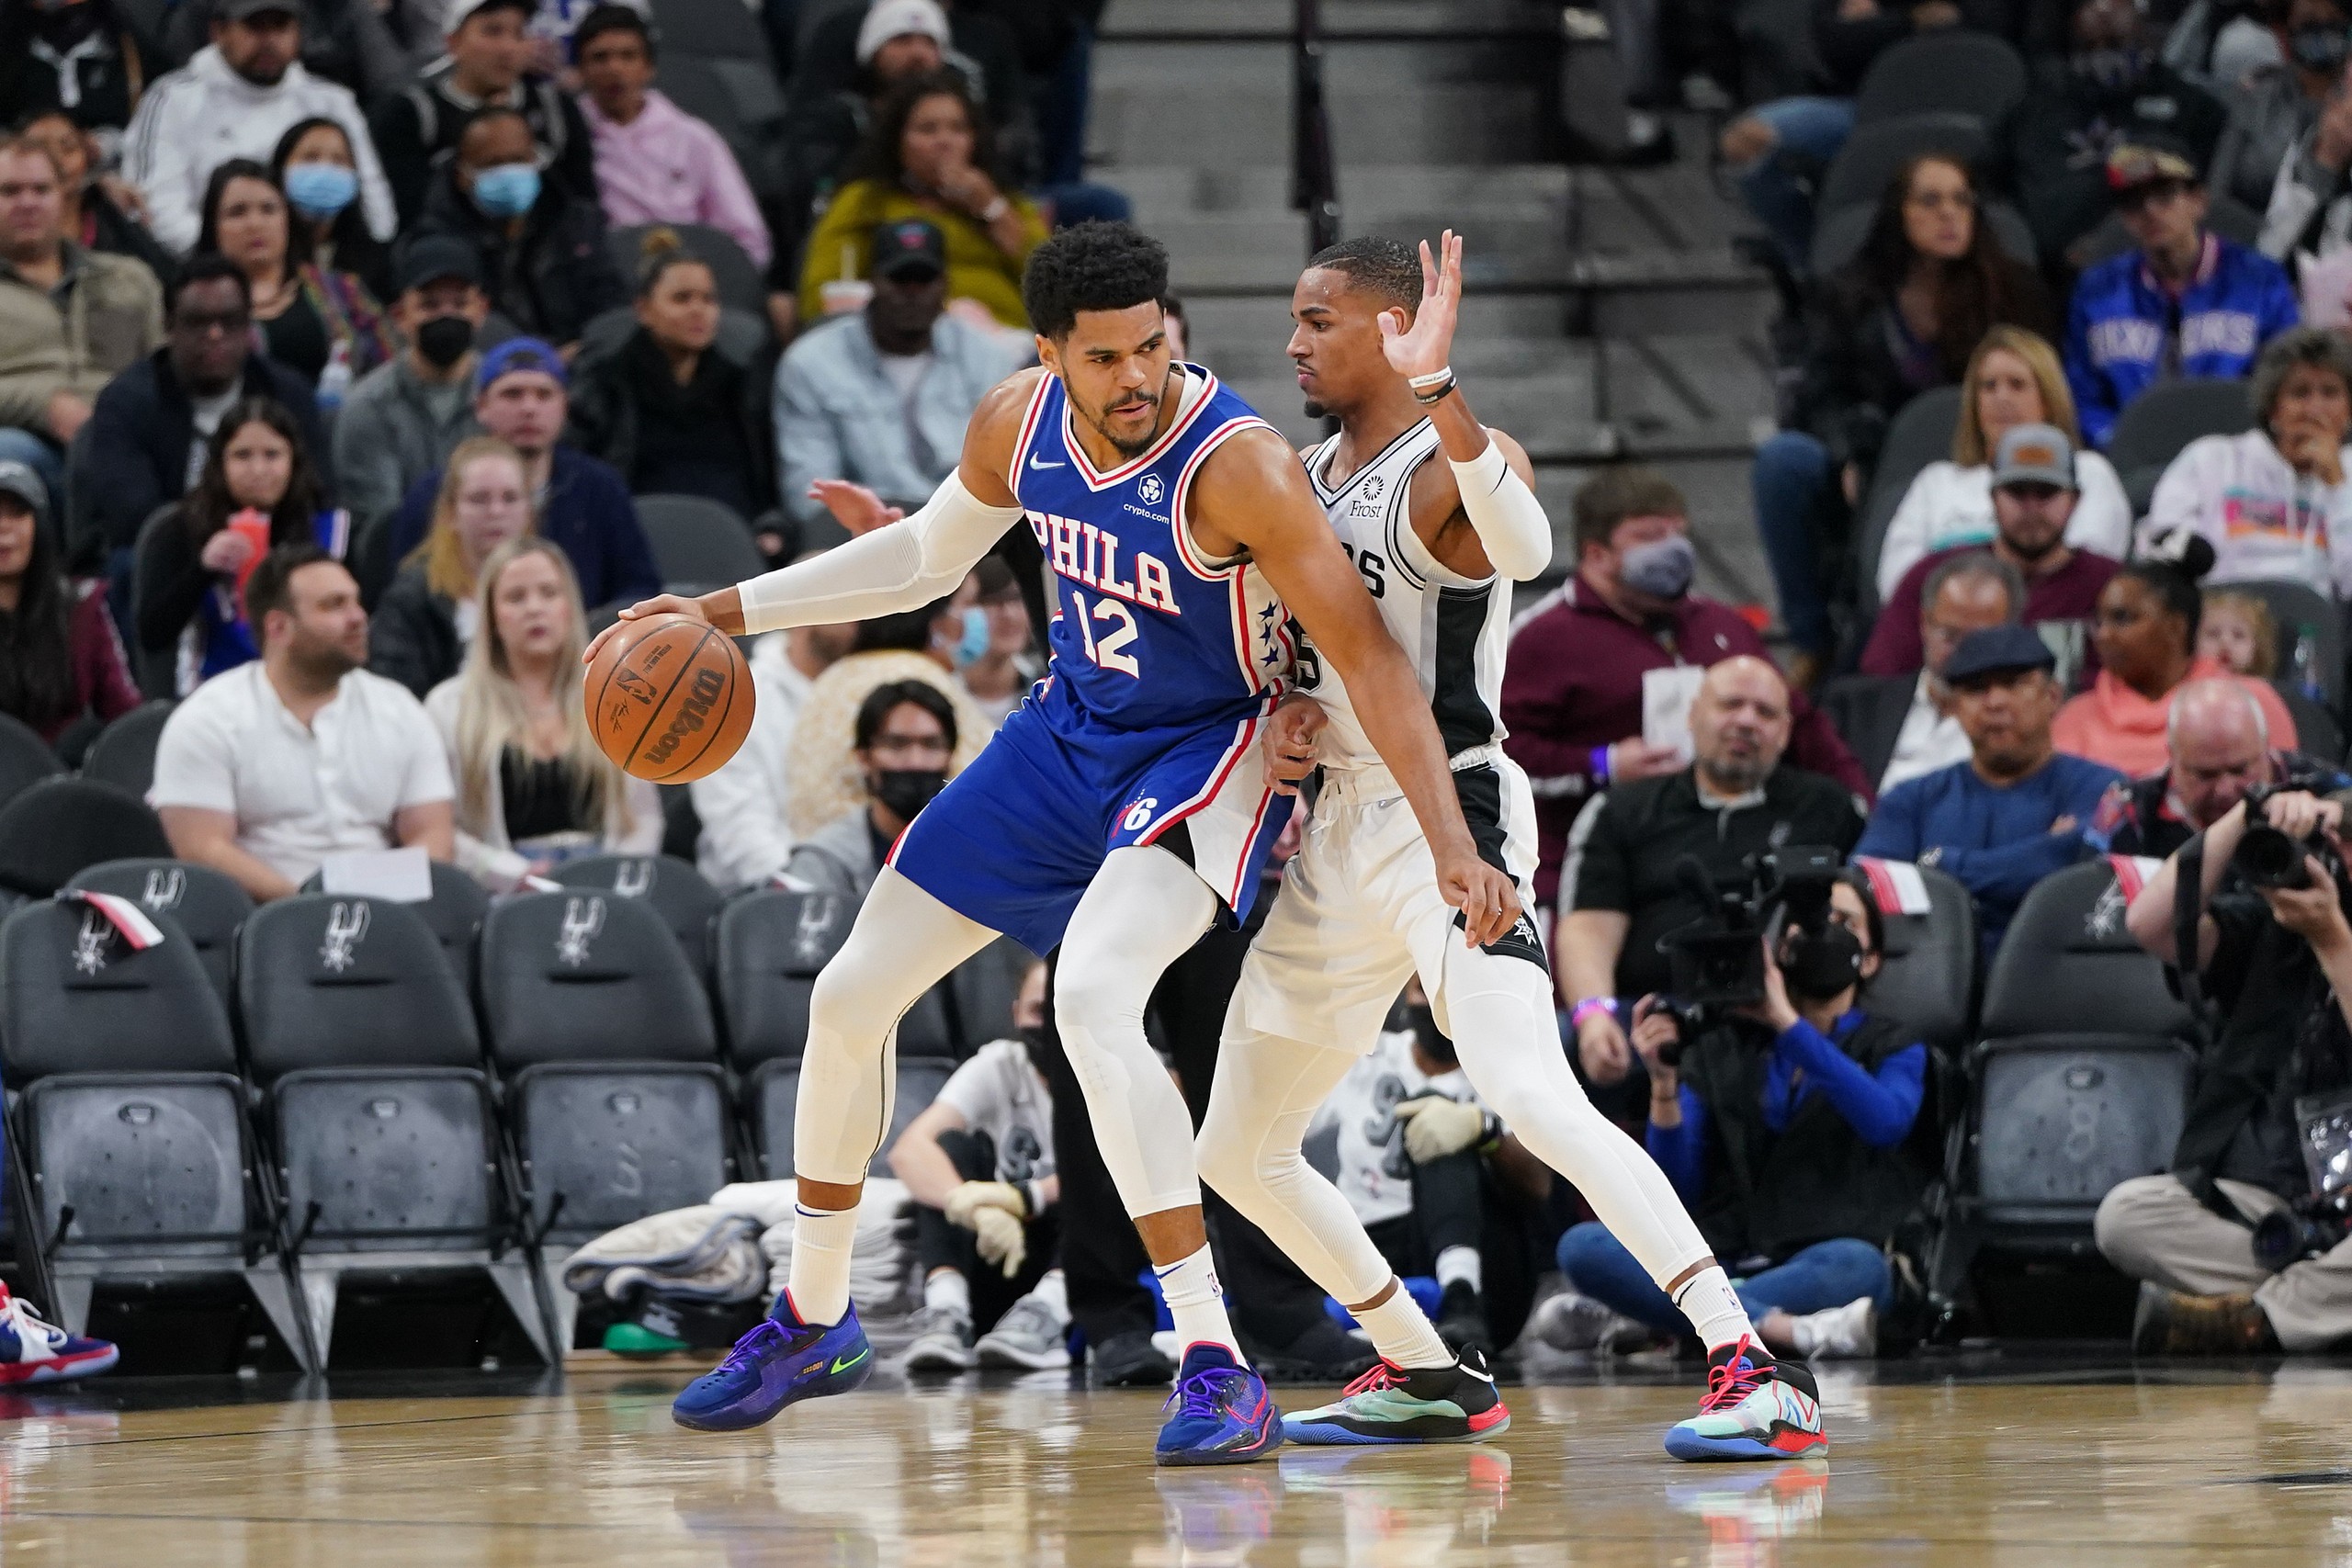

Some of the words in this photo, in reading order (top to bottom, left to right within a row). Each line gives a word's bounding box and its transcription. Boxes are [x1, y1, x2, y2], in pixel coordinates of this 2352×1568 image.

[1124, 502, 1170, 525] crypto.com
[1350, 500, 1383, 518] Frost
[1024, 508, 1182, 615] PHILA
[1071, 590, 1140, 680] 12
[645, 668, 726, 764] Wilson
